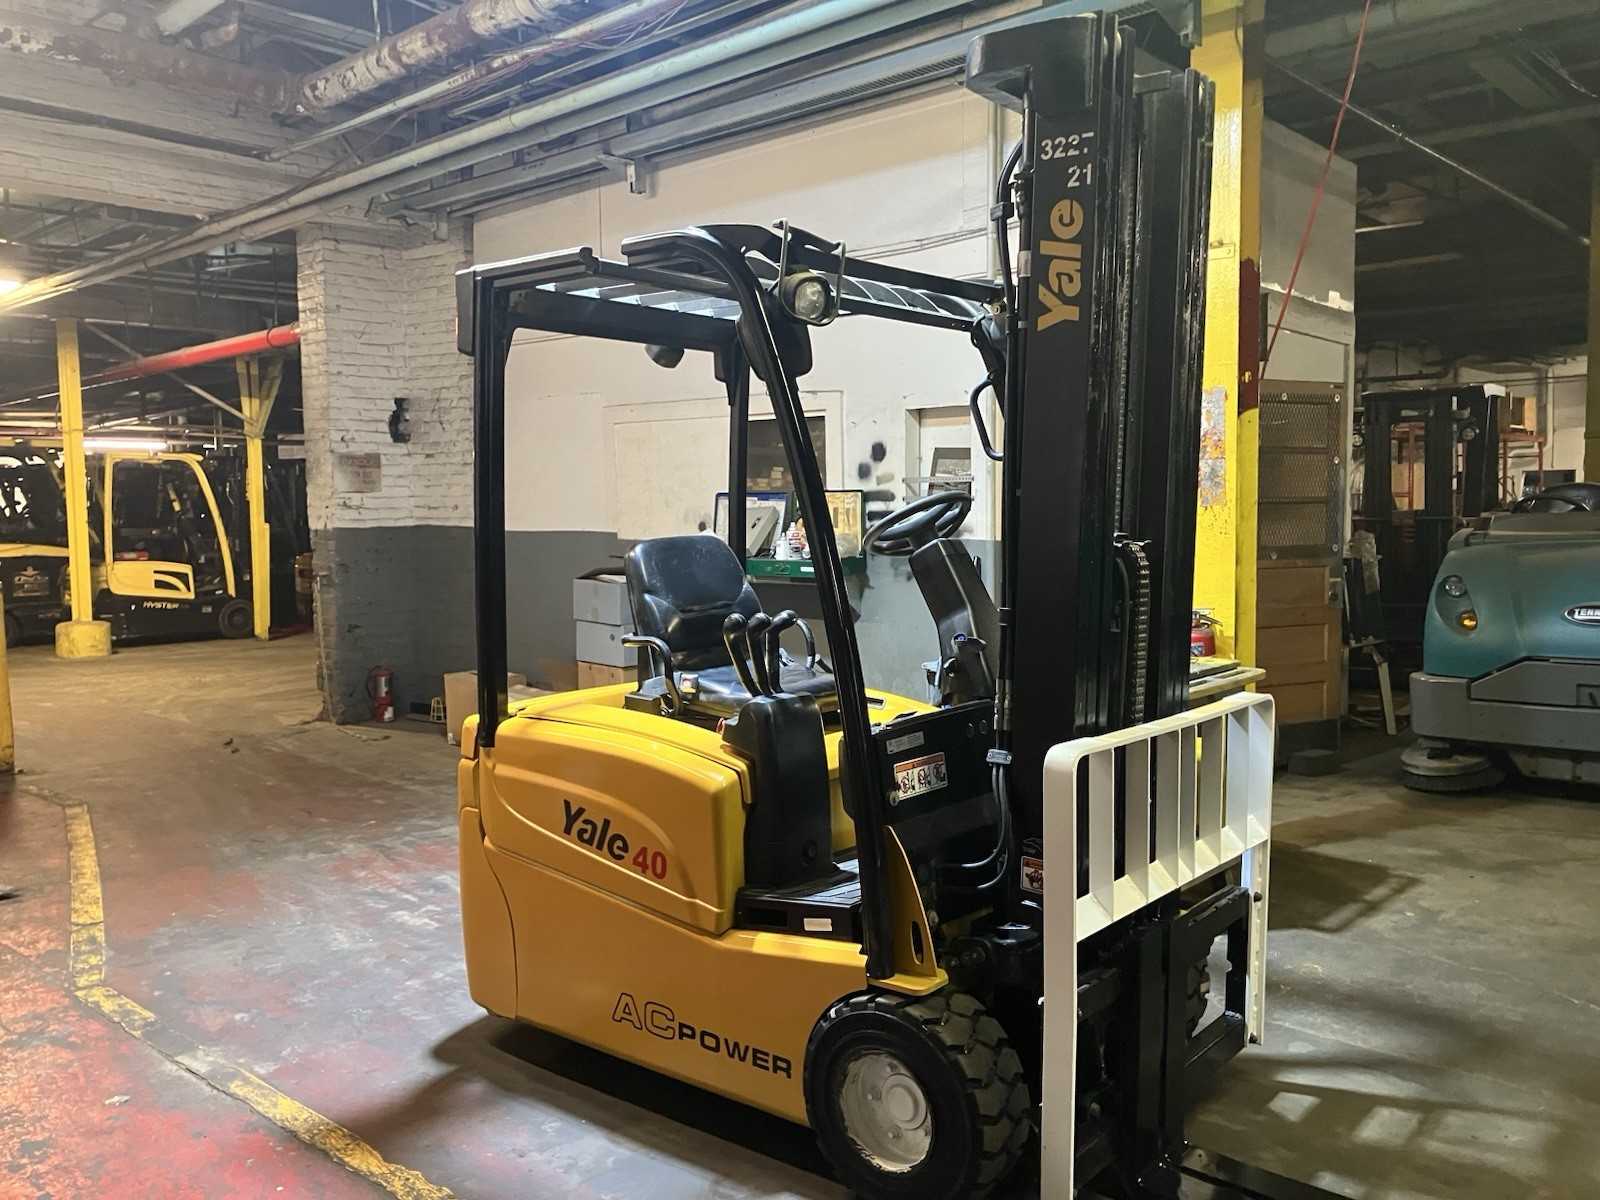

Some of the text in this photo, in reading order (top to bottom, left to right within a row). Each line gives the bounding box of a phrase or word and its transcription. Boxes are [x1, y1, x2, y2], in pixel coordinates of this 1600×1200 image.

[1067, 162, 1092, 187] 21
[1038, 198, 1084, 331] Yale
[563, 799, 668, 880] Yale 40
[678, 1021, 793, 1080] POWER
